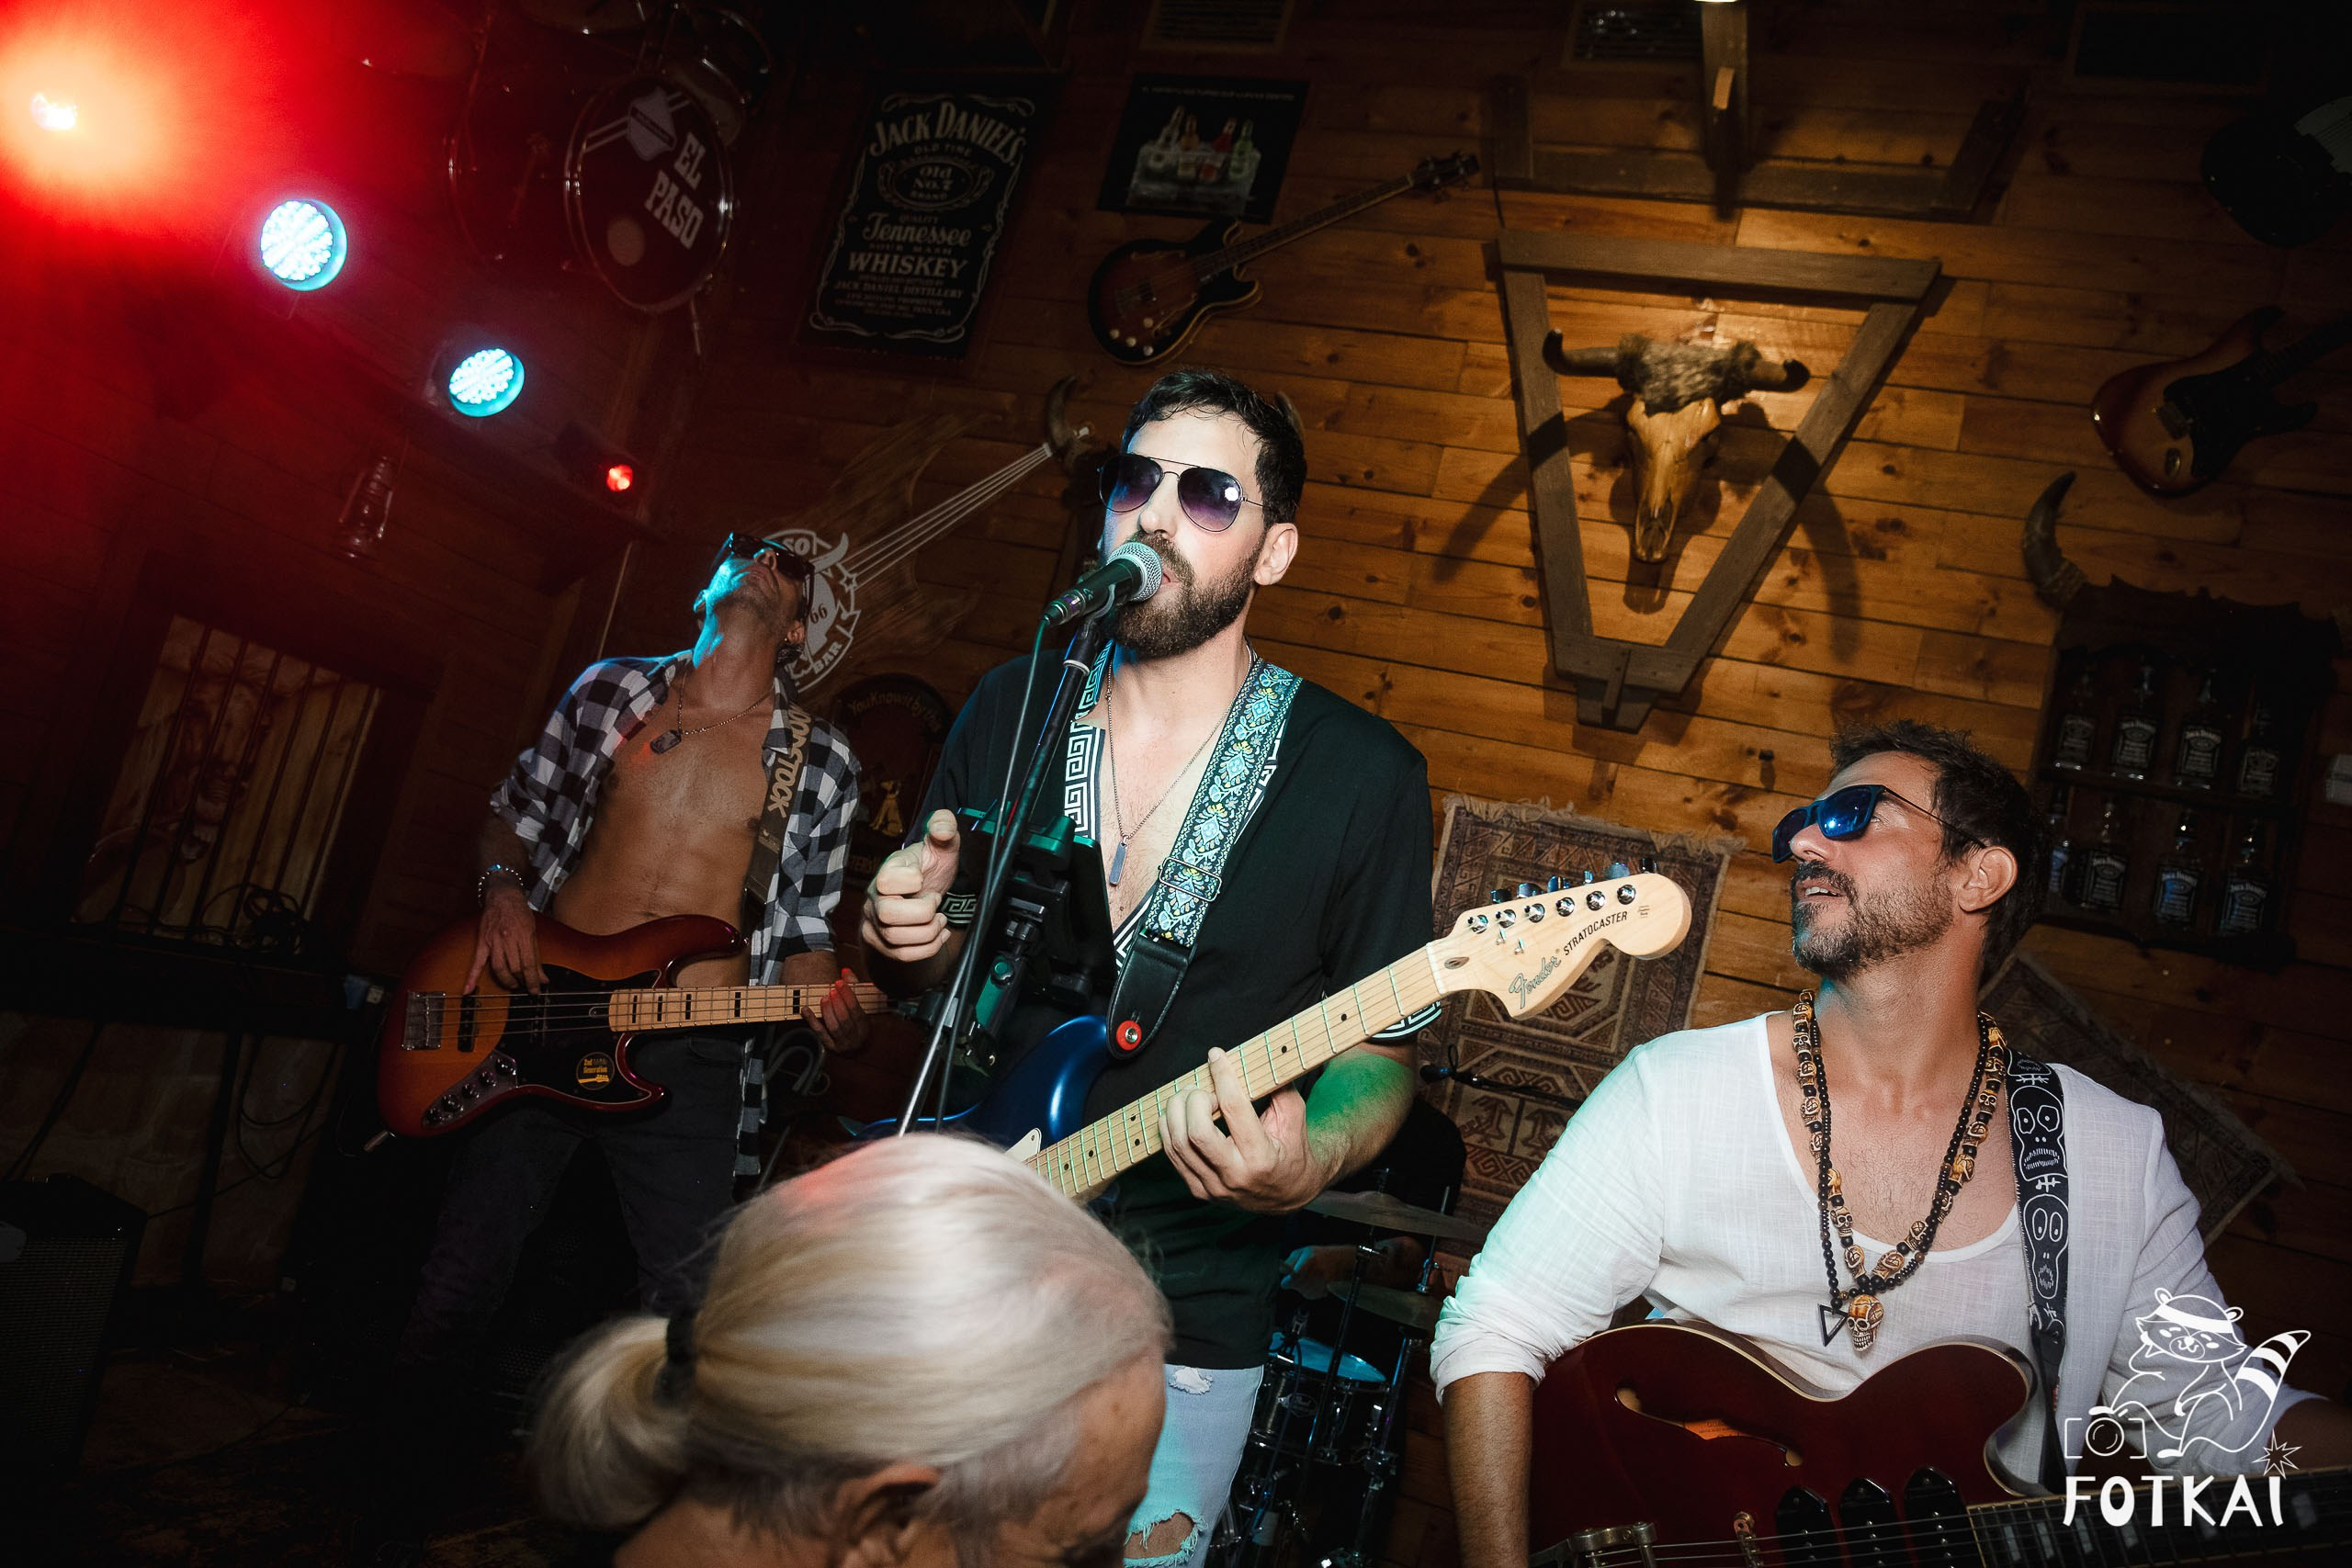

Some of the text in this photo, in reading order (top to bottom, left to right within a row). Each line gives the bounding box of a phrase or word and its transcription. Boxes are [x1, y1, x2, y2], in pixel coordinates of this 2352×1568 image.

[868, 100, 1028, 166] JACK DANIEL'S
[673, 131, 707, 191] EL
[919, 165, 954, 179] Old
[644, 169, 705, 250] PASO
[862, 210, 972, 247] Tennessee
[848, 251, 969, 279] WHISKEY
[813, 641, 843, 675] BAR
[1563, 910, 1629, 956] STRATOCASTER
[1508, 957, 1562, 1010] Fender
